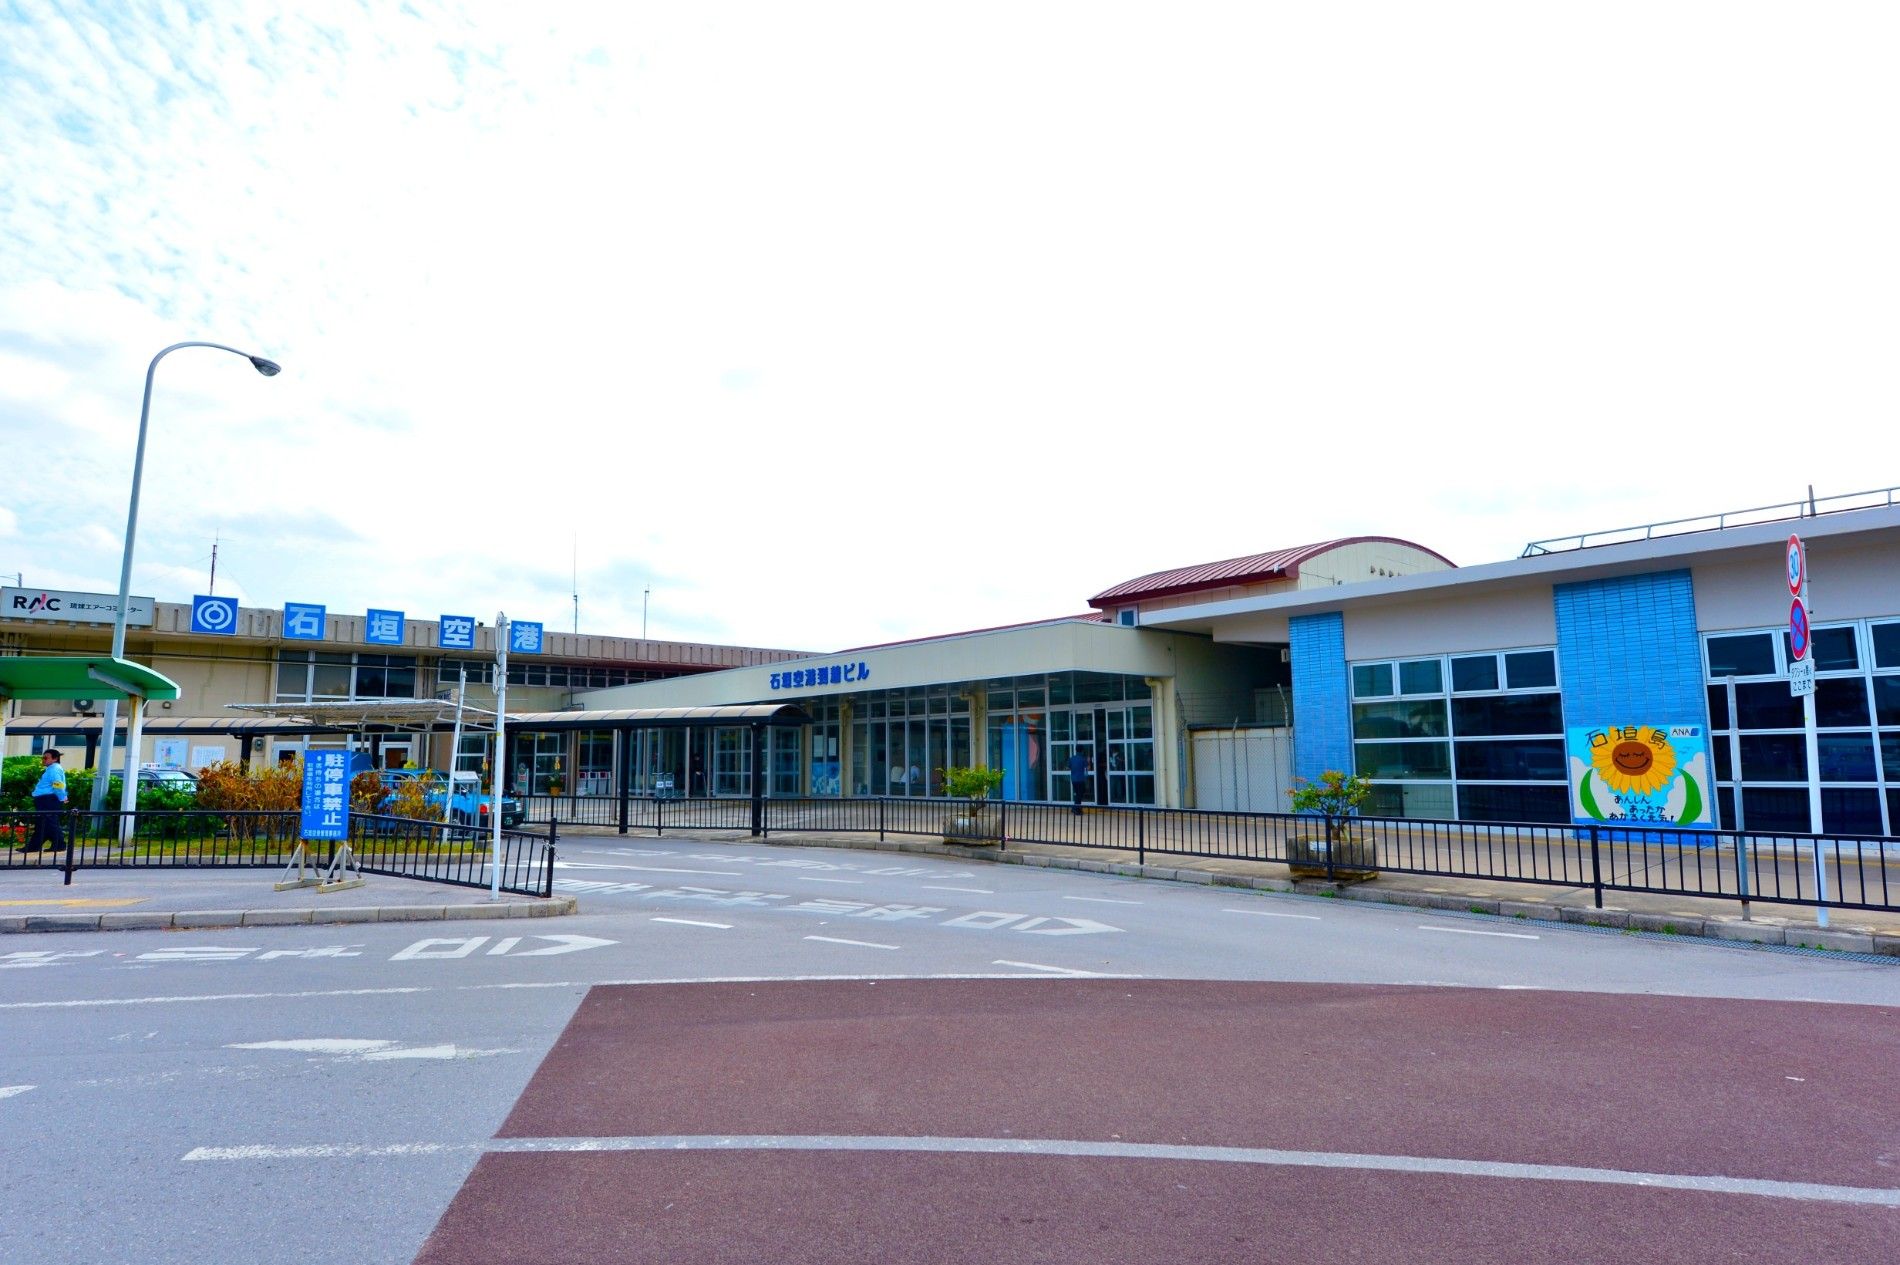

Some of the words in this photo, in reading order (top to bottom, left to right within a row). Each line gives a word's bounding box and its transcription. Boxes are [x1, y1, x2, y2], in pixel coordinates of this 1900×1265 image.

[1790, 550, 1799, 580] 30
[13, 592, 61, 614] RAC
[70, 602, 143, 613] 琉球エアーコミター
[287, 605, 540, 652] 石垣空港
[770, 661, 869, 689] 石垣空港到着ビル
[1585, 726, 1668, 750] 石垣島
[1671, 728, 1691, 736] ANA
[322, 753, 344, 826] 駐停車禁止
[1614, 795, 1651, 804] あんしん
[1629, 805, 1665, 813] あったか
